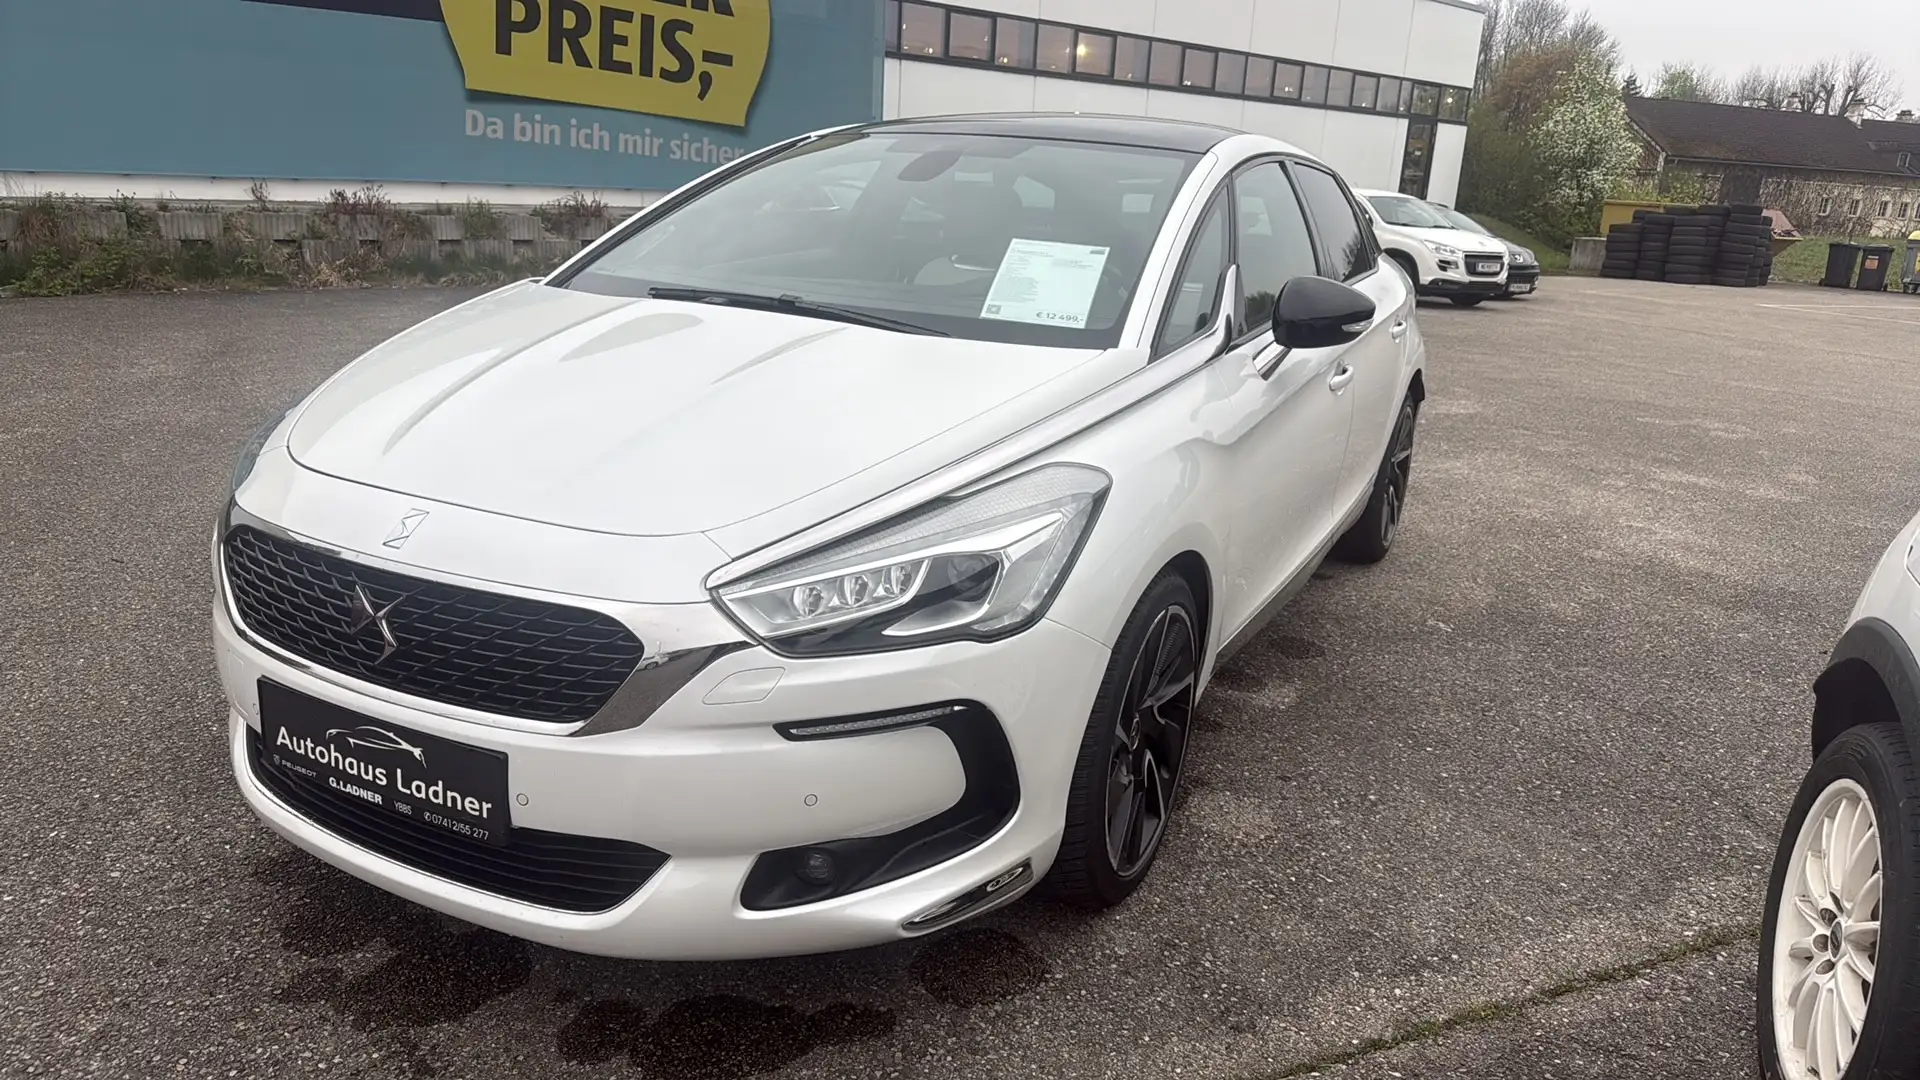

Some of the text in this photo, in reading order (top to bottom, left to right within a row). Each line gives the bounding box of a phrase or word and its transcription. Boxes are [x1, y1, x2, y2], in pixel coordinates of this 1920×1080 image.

[464, 109, 504, 140] Da
[514, 113, 561, 146] bin
[570, 118, 610, 152] ich
[618, 128, 663, 158] mir
[1046, 312, 1057, 320] 12
[276, 725, 493, 819] Autohaus Ladner
[281, 759, 317, 778] PEUGEOT
[328, 776, 383, 805] G.LADNER
[393, 800, 413, 815] YBBS
[431, 813, 489, 840] 07412/55 277
